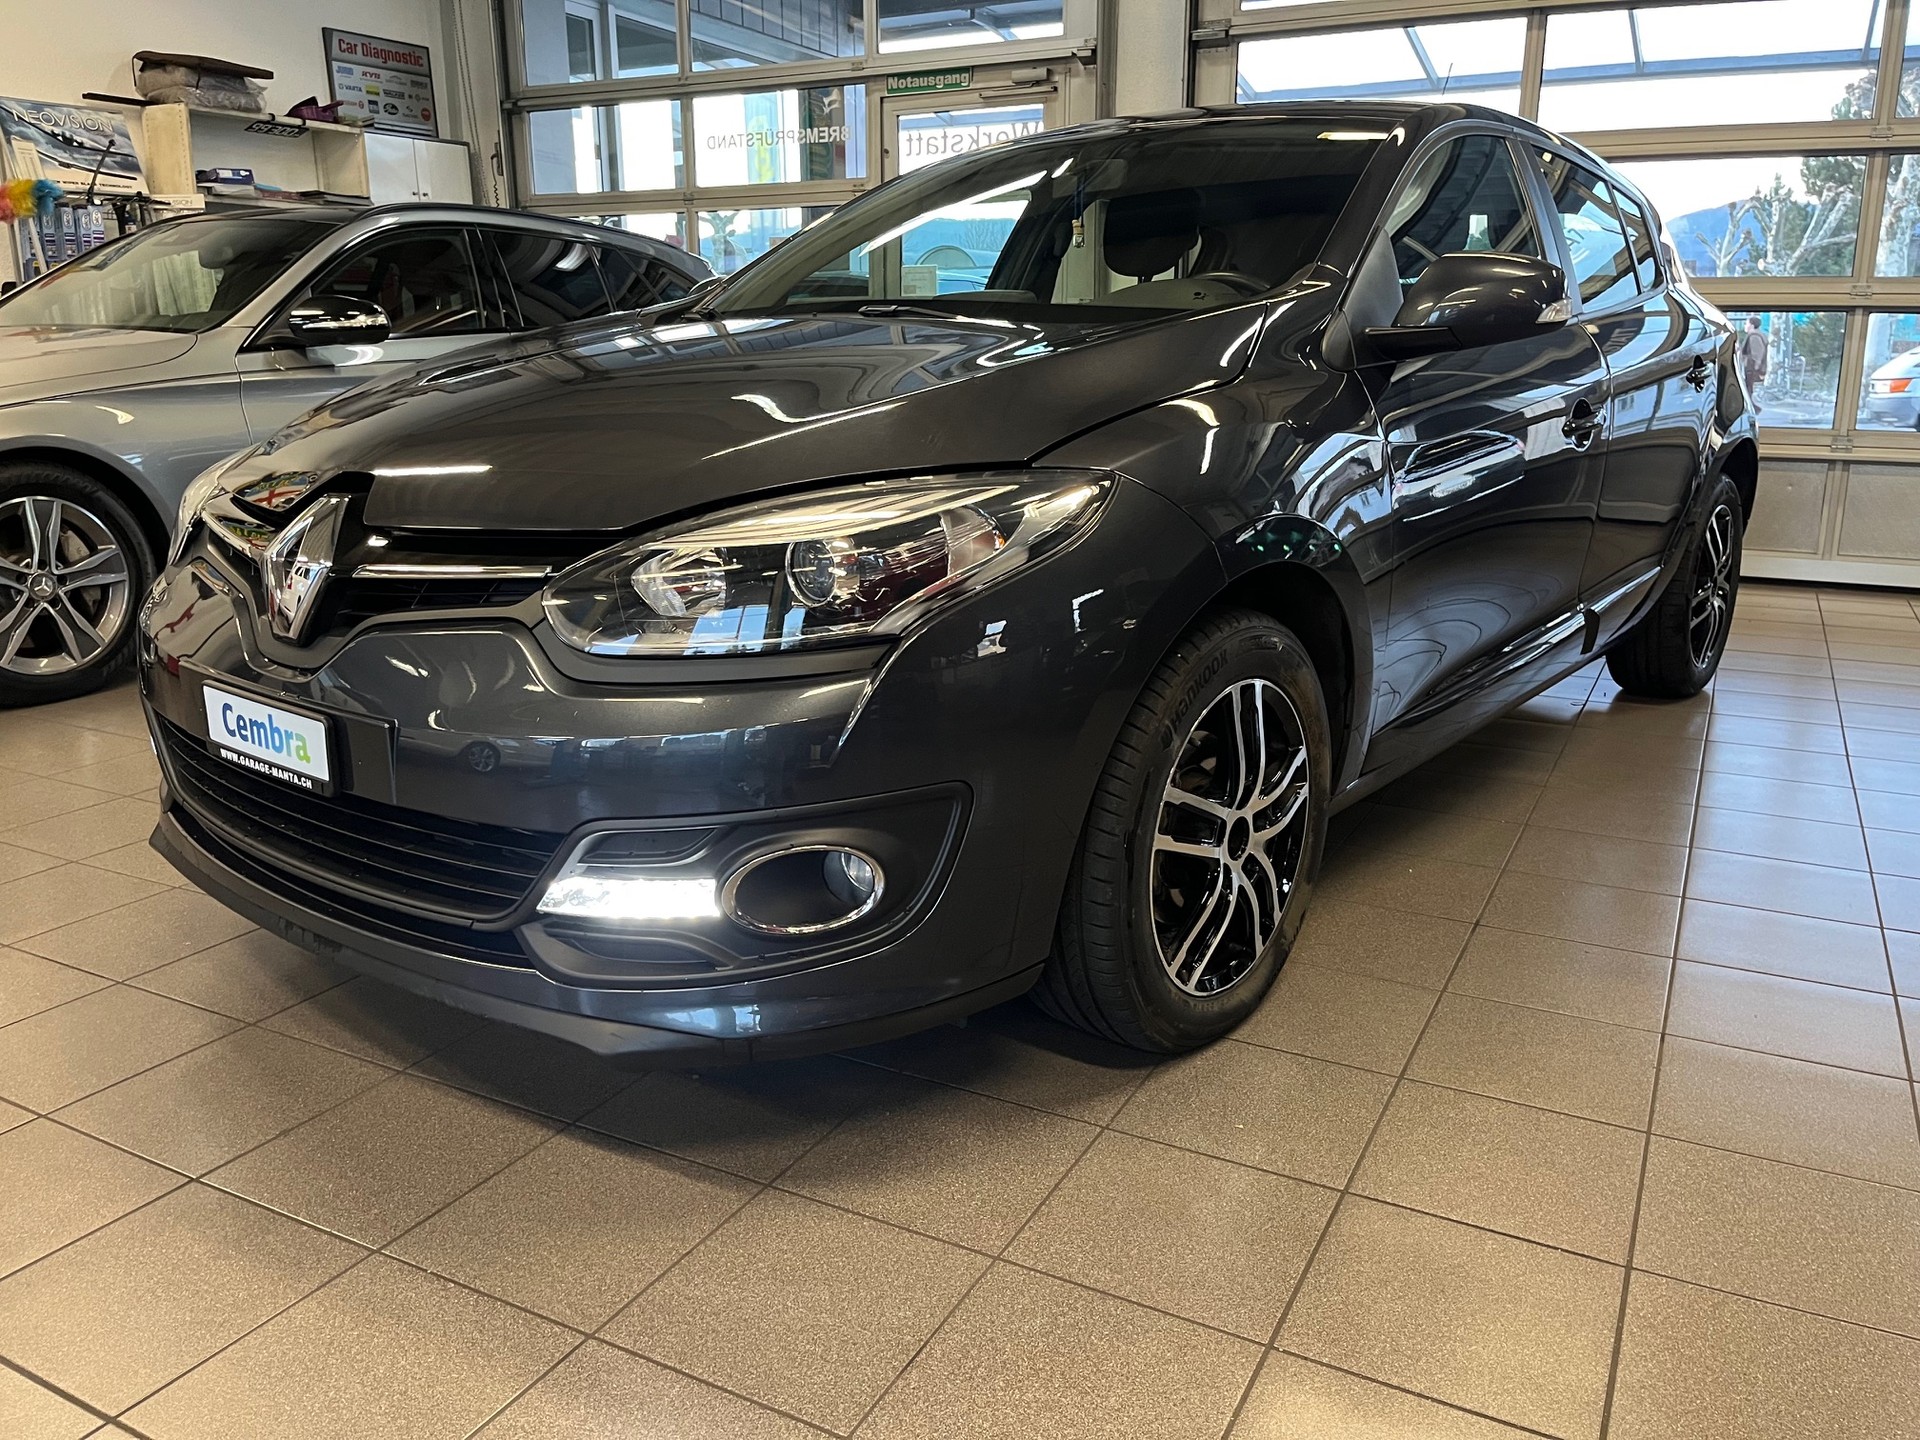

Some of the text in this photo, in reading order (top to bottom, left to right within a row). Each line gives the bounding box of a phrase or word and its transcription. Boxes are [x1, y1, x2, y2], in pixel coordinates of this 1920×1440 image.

[338, 38, 424, 67] Car Diagnostic
[887, 71, 970, 90] Notausgang
[12, 108, 114, 132] NEOVISION
[222, 702, 311, 764] Cembra
[220, 747, 313, 790] WWW.GARAGE-MANTA.CH
